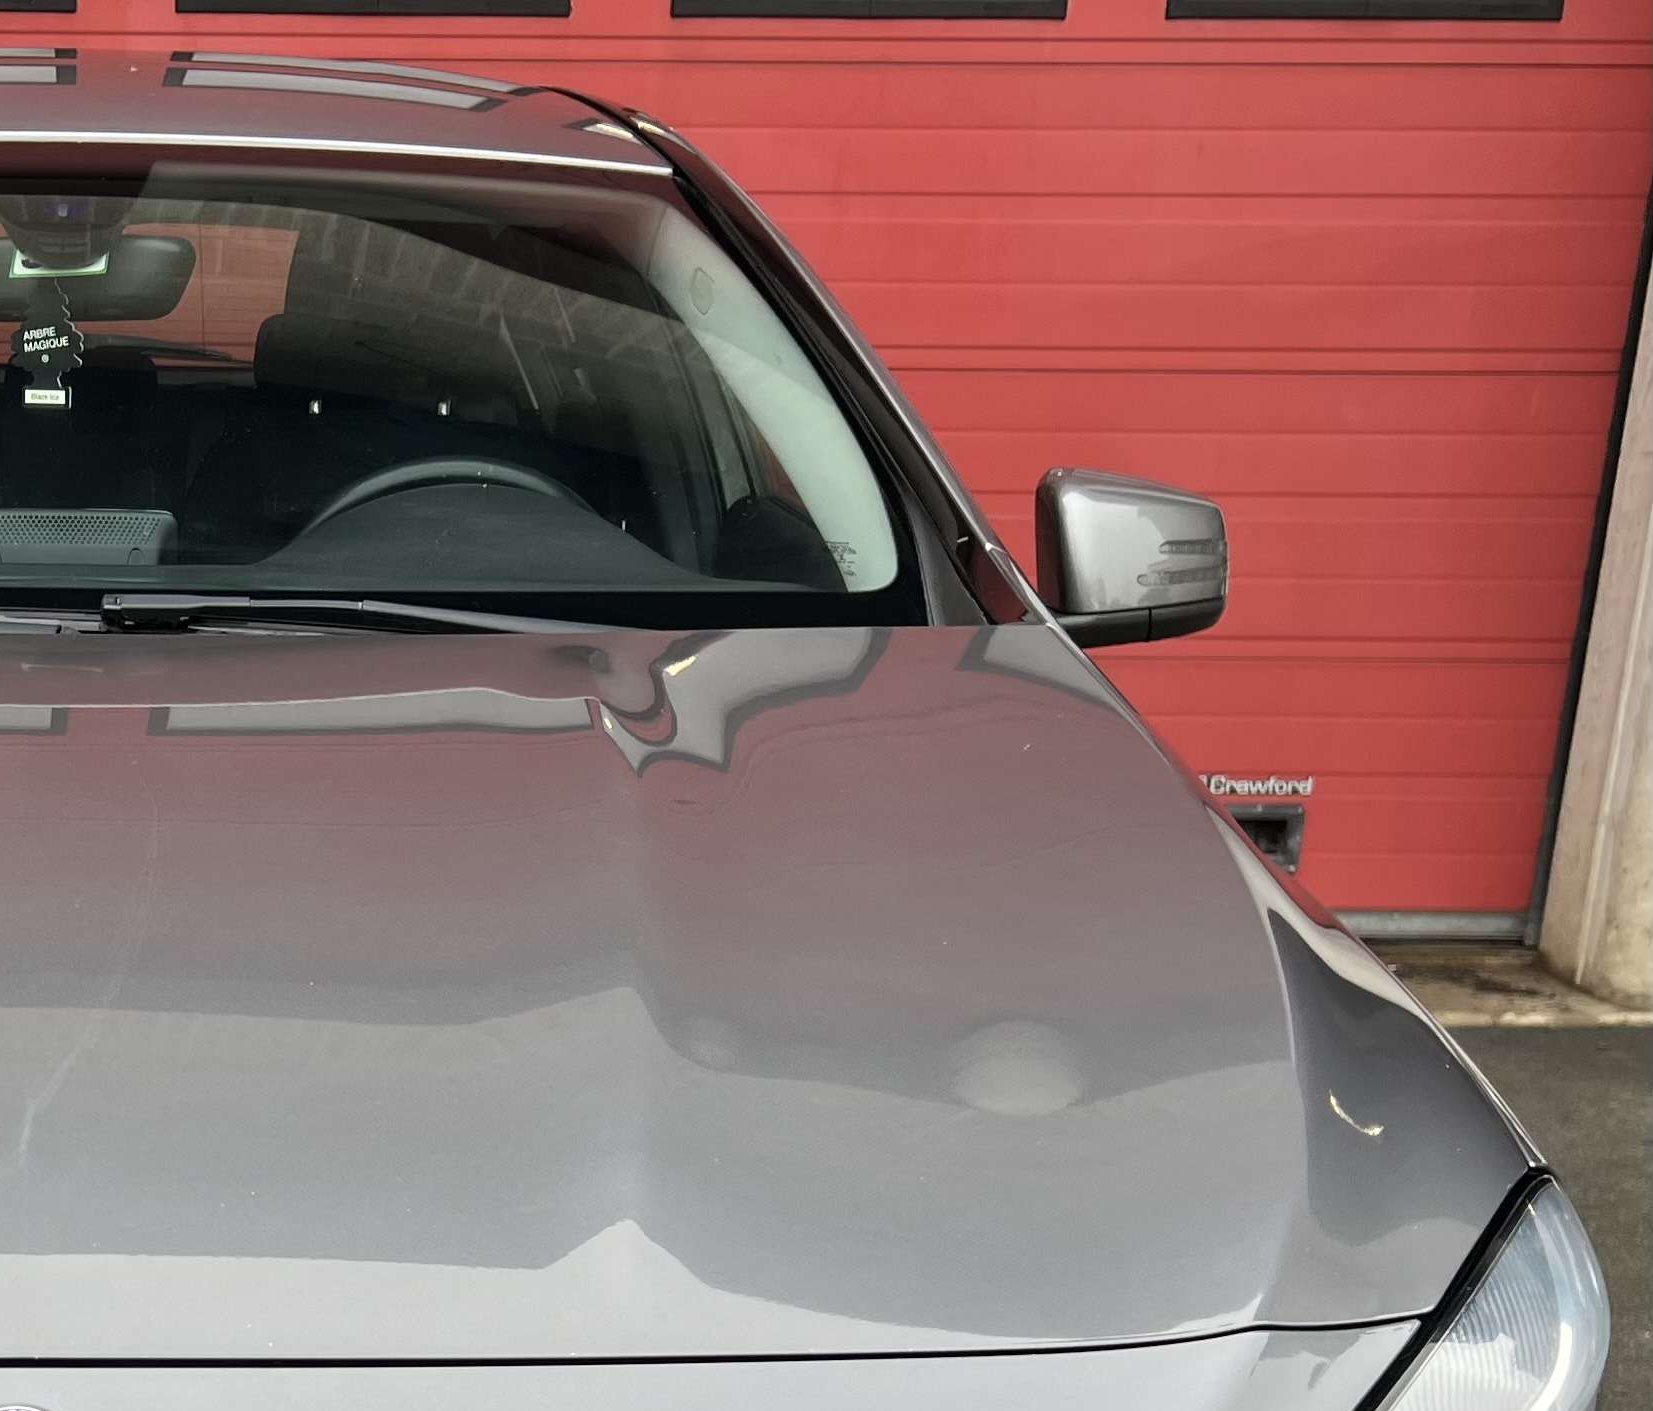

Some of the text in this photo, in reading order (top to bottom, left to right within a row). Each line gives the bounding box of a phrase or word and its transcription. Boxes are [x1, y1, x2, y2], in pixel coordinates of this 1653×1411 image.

[23, 326, 56, 340] ARBRE
[23, 336, 69, 352] MAGIQUE
[1209, 774, 1314, 796] Crawford
